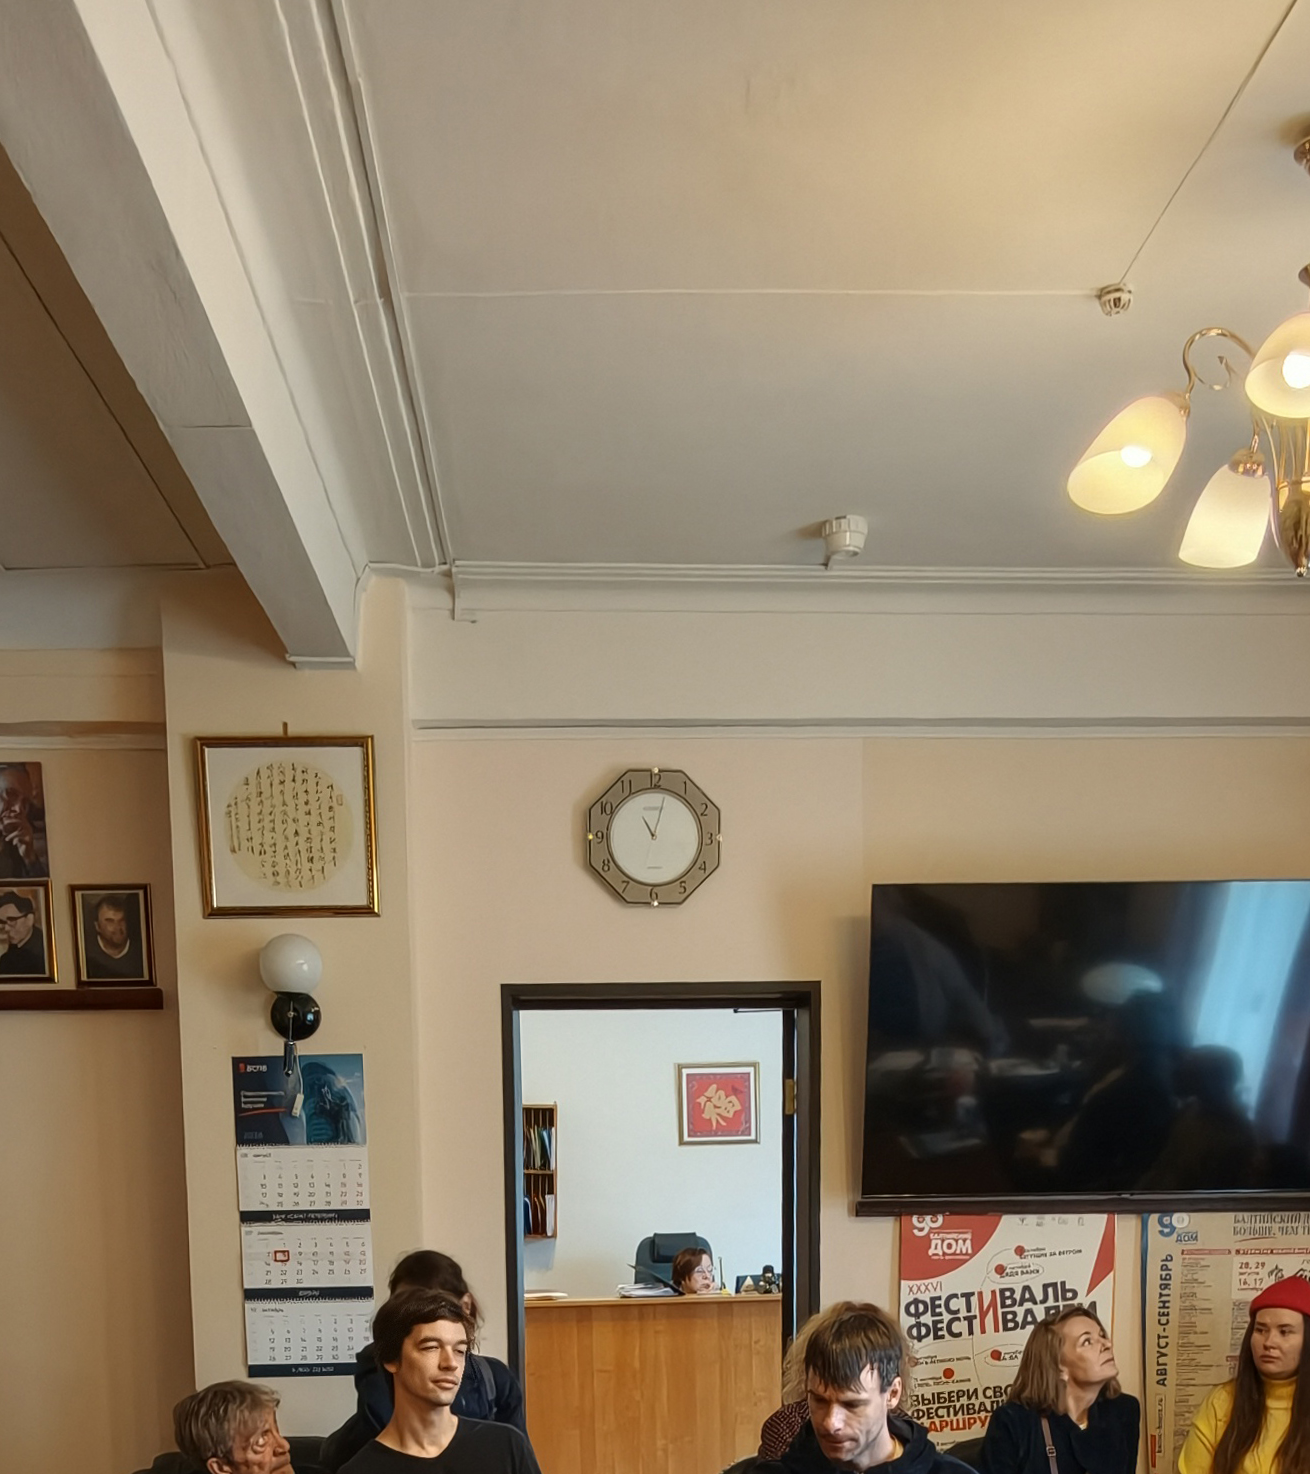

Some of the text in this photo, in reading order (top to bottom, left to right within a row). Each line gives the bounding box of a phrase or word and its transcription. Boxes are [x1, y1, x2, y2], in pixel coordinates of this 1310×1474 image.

[621, 779, 632, 795] 11
[650, 772, 662, 788] 12
[682, 780, 688, 795] 1
[600, 801, 613, 815] 10
[701, 803, 708, 816] 2
[595, 831, 604, 844] 9
[705, 832, 713, 846] 3
[602, 859, 610, 873] 8
[698, 861, 707, 874] 4
[621, 881, 630, 894] 7
[650, 887, 658, 900] 6
[679, 881, 687, 894] 5
[928, 1239, 972, 1256] ДОМ
[907, 1281, 942, 1295] XXXVI
[904, 1280, 1078, 1321] ФЕСТИВАЛЬ
[1156, 1253, 1173, 1387] АВГУСТ-СЕНТЯБРЬ
[910, 1384, 1012, 1408] ВЫБЕРИ СВО
[928, 1415, 989, 1432] АРШРУ
